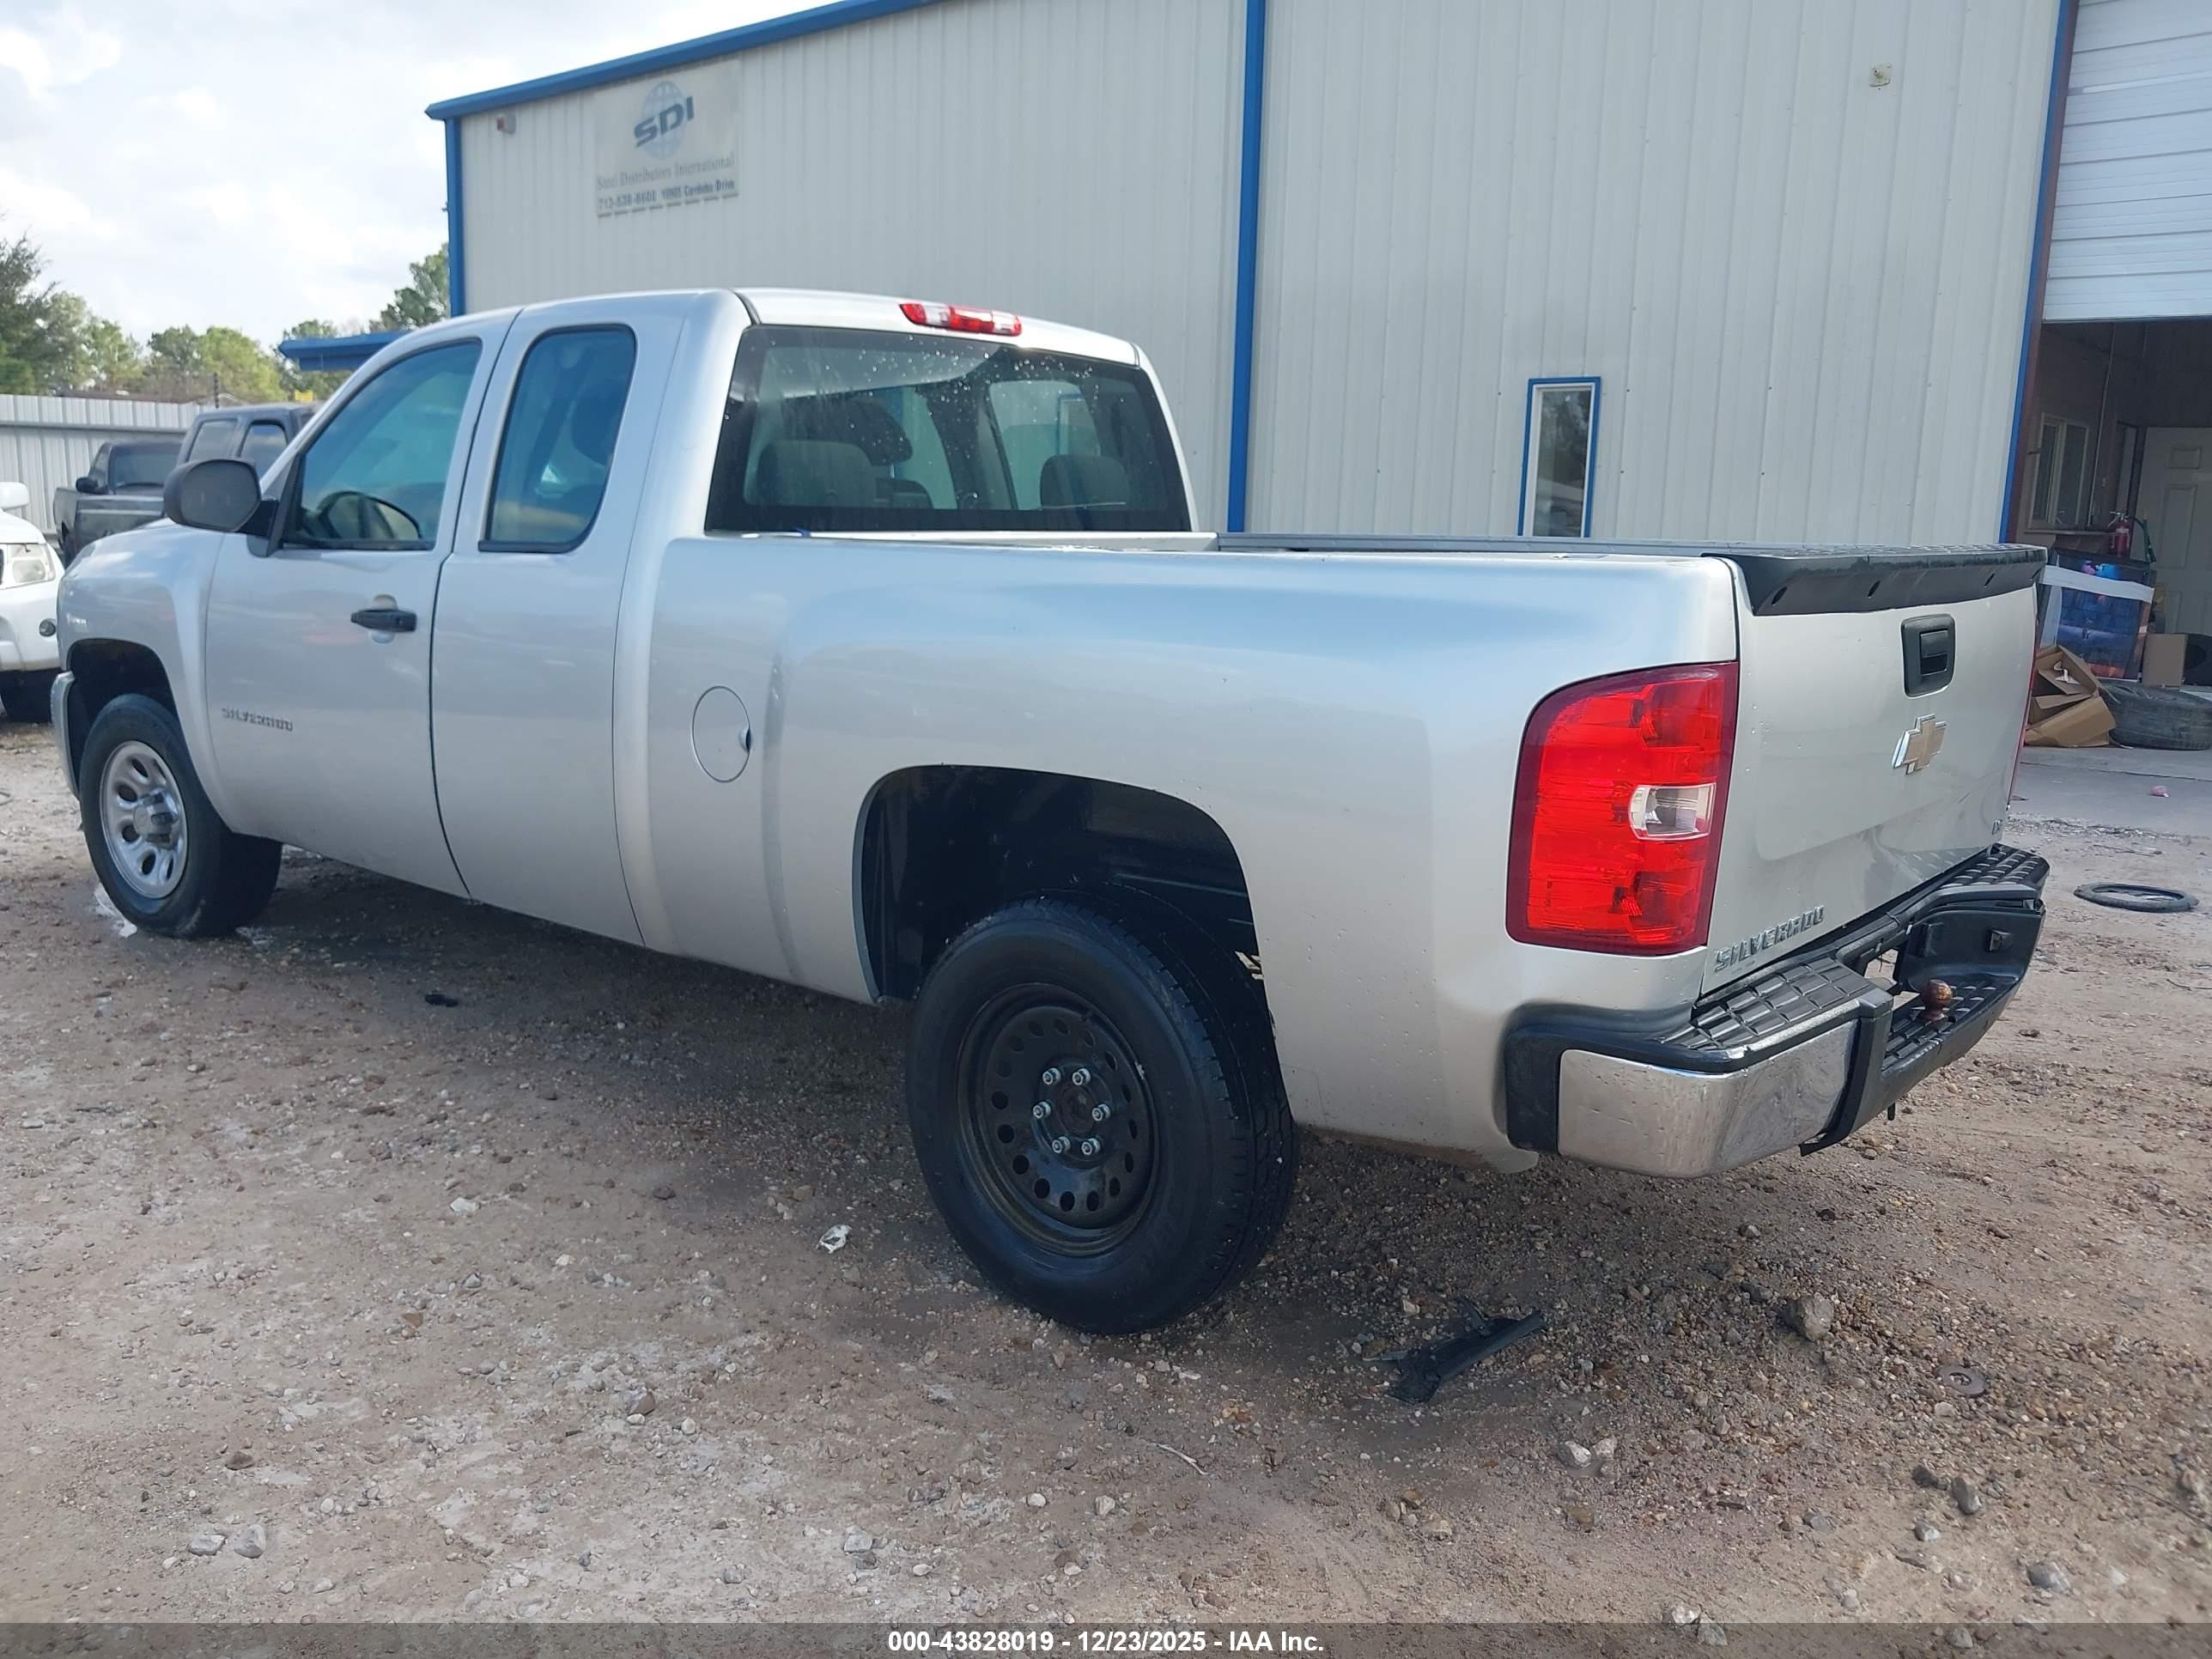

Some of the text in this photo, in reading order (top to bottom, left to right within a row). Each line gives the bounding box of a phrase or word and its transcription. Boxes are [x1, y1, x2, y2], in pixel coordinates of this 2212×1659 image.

[634, 96, 695, 148] SDI
[674, 154, 735, 175] International
[715, 178, 735, 191] Drive
[1715, 906, 1825, 972] SILVERADO
